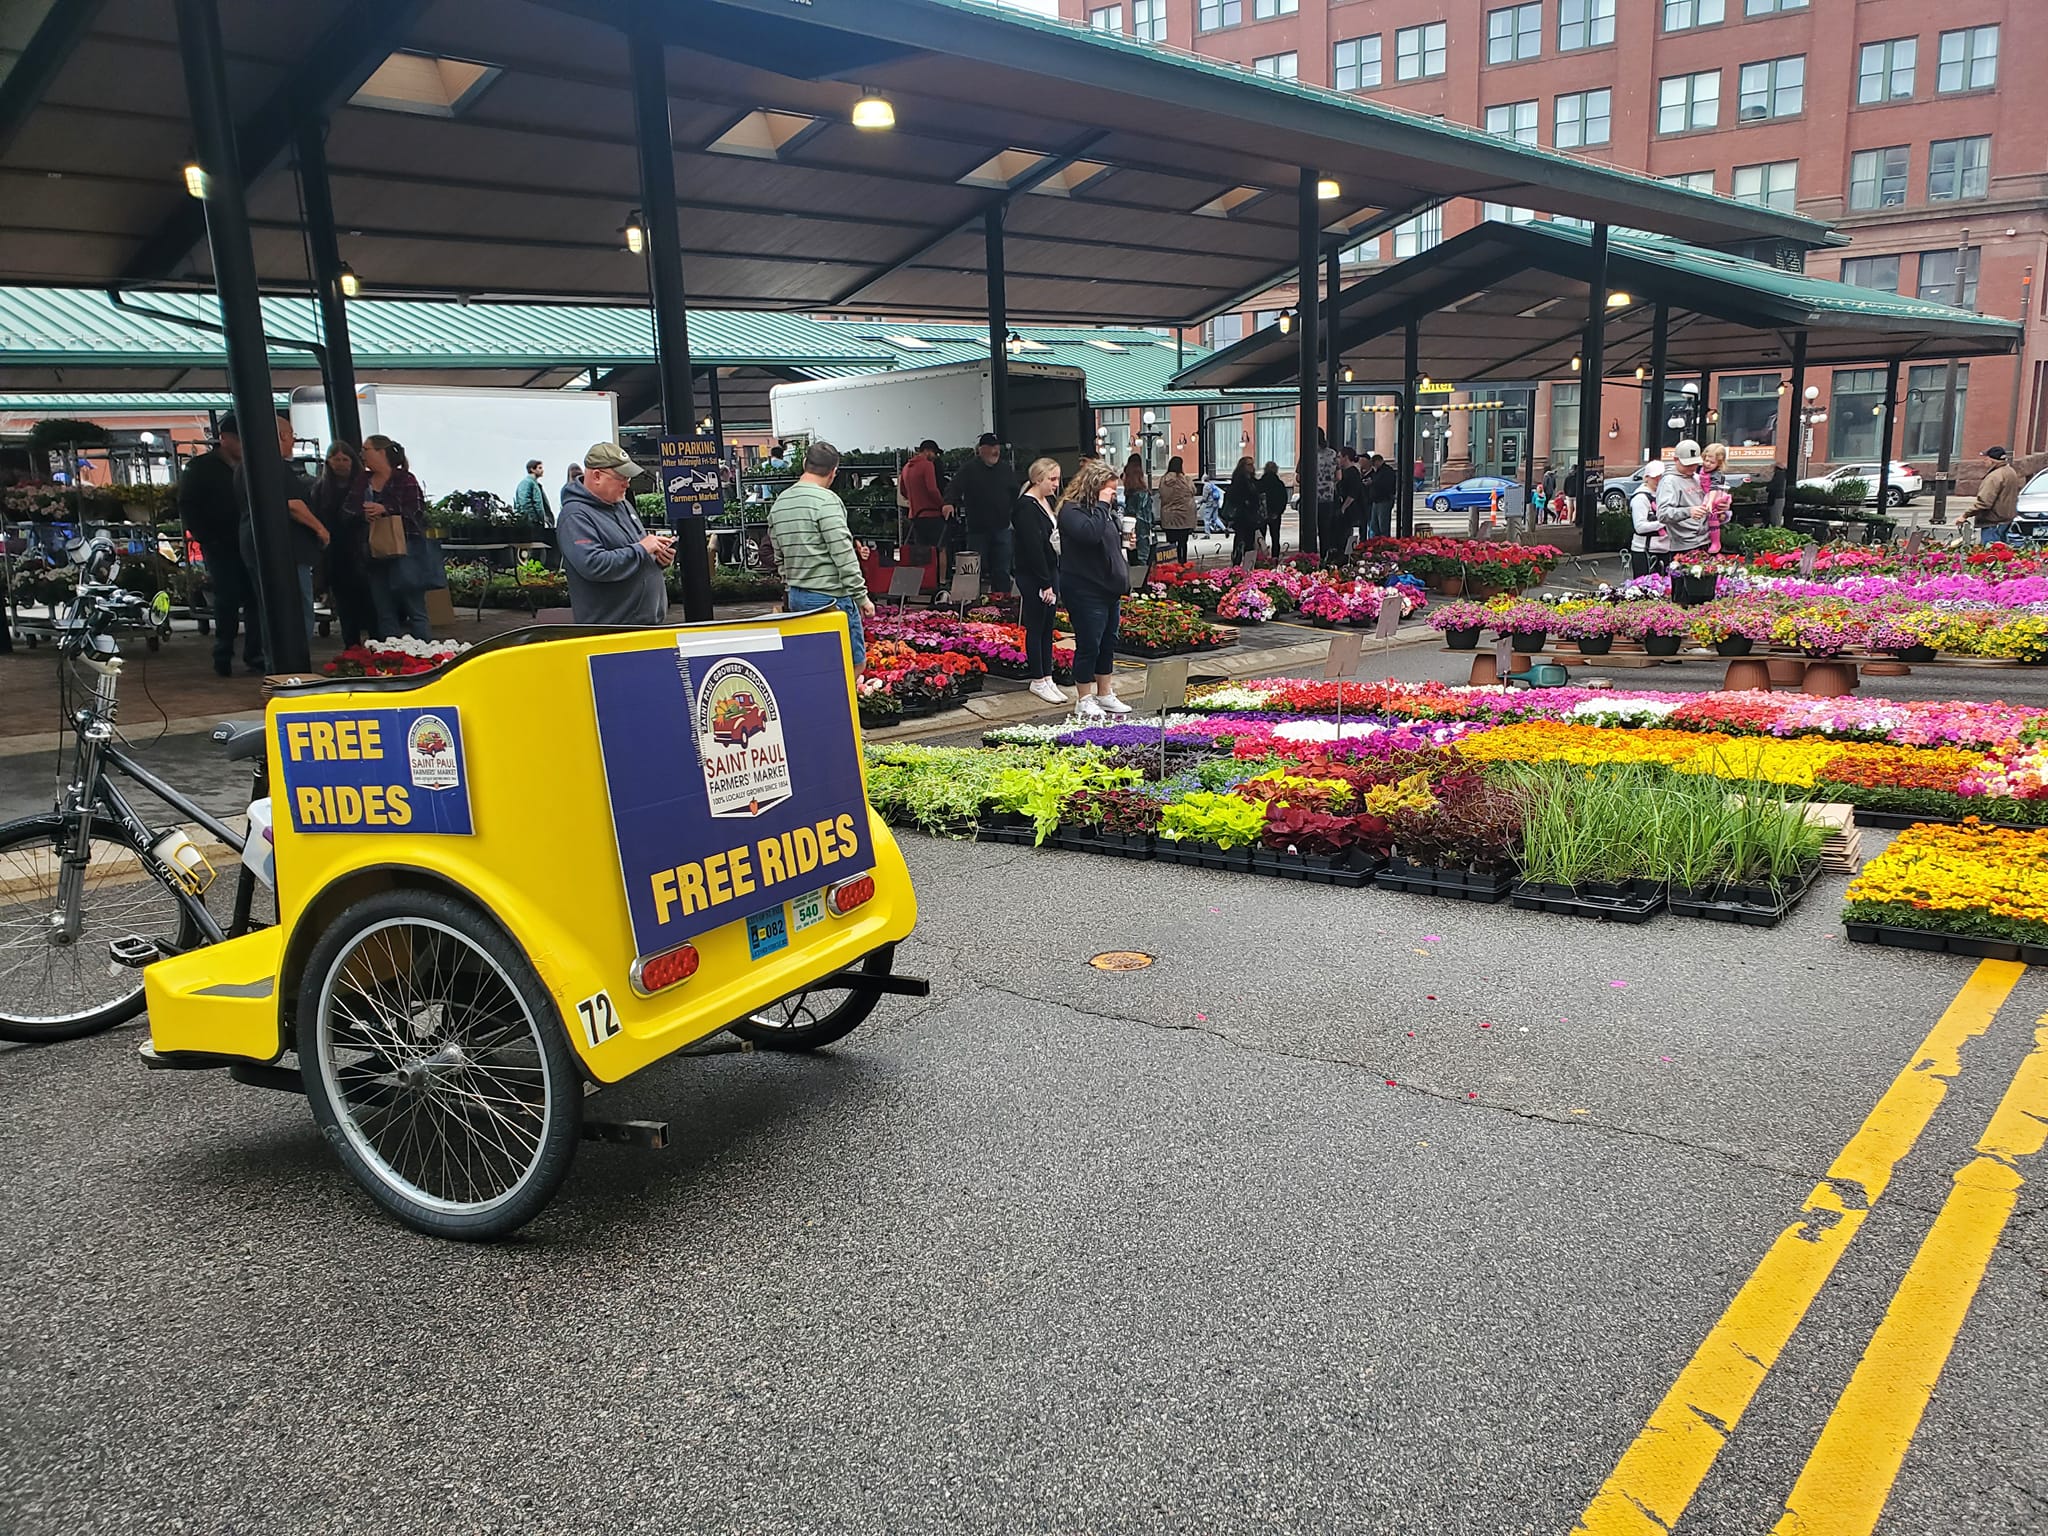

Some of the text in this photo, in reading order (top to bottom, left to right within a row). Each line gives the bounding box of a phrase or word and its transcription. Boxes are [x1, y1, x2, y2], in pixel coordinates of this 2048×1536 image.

[661, 441, 716, 456] NO PARKING
[663, 459, 676, 467] After
[678, 458, 701, 467] Midnight
[670, 492, 719, 503] Farmers Market
[704, 680, 716, 701] PAUL
[744, 669, 777, 721] ASSOCIATION
[286, 719, 384, 761] FREE
[412, 758, 456, 768] SAINT PAUL
[705, 744, 785, 778] SAINT PAUL
[709, 765, 787, 794] FARMERS' MARKET
[296, 785, 412, 826] RIDES
[712, 796, 725, 806] 100%
[725, 791, 746, 804] LOCALLY
[747, 787, 765, 798] GROWN
[765, 784, 778, 793] SINCE
[650, 814, 858, 925] FREE RIDES
[799, 903, 819, 921] 540
[578, 993, 620, 1044] 72
